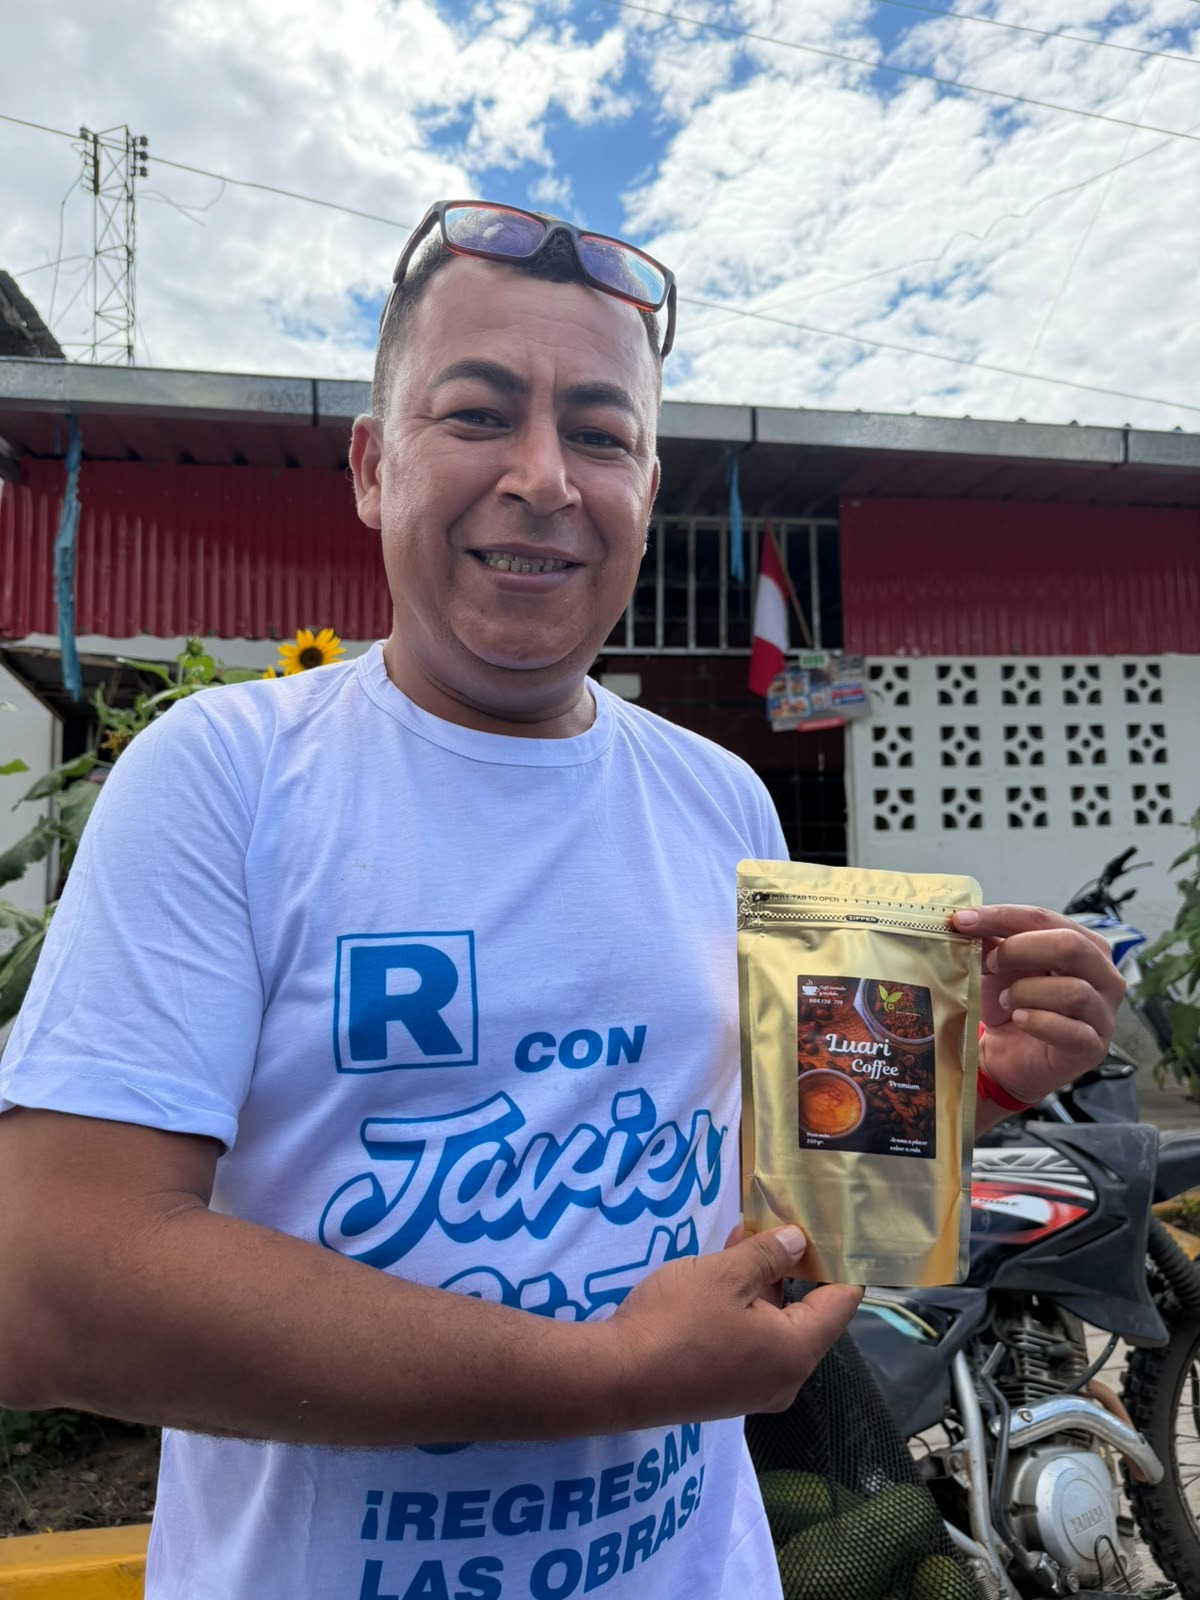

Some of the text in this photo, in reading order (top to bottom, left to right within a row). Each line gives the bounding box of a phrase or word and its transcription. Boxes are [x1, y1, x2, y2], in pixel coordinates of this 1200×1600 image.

[818, 895, 840, 903] OPEN
[348, 943, 464, 1062] R
[514, 1024, 648, 1074] CON
[825, 1033, 892, 1057] Luari
[851, 1058, 900, 1080] Coffee
[888, 1080, 921, 1091] Premium
[319, 1087, 728, 1270] Javier
[360, 1422, 701, 1542] ¡REGRESAN
[359, 1465, 706, 1600] LAS OBRAS!
